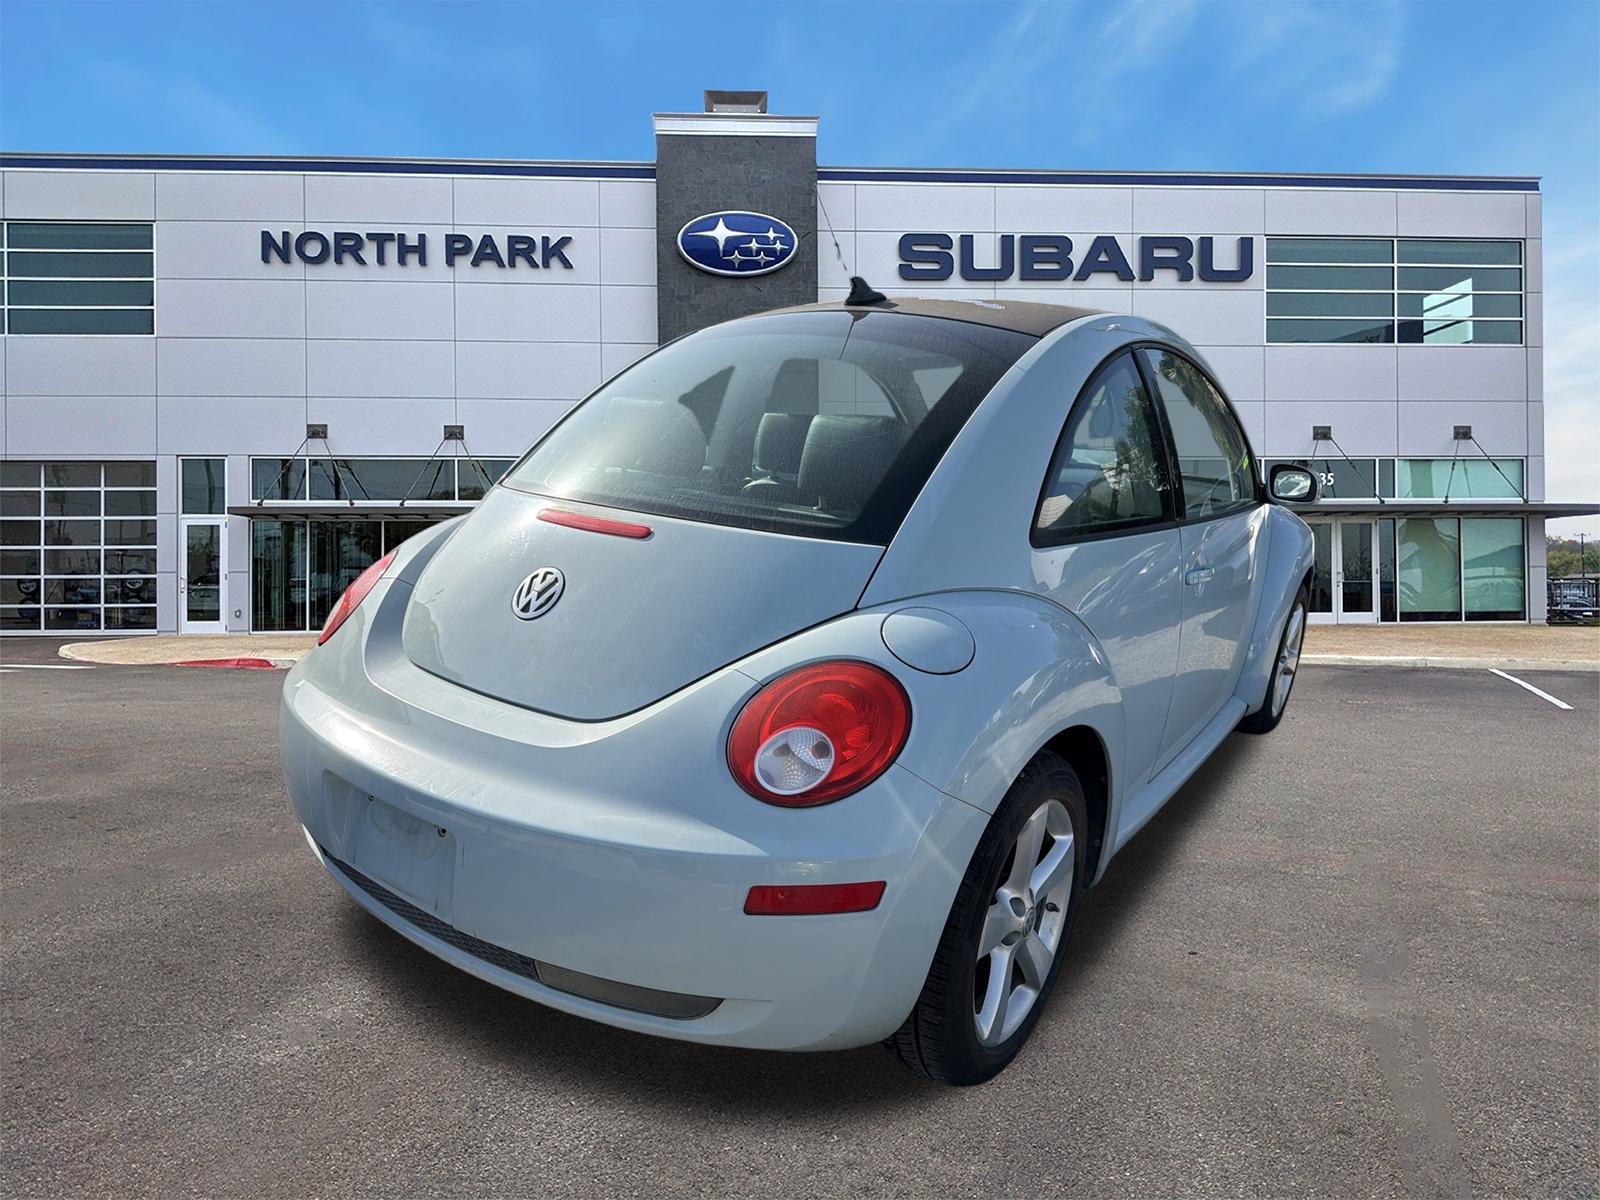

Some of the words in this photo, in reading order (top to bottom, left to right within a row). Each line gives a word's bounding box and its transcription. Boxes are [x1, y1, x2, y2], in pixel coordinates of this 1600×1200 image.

[260, 230, 428, 266] NORTH
[444, 233, 574, 269] PARK
[898, 233, 1254, 282] SUBARU
